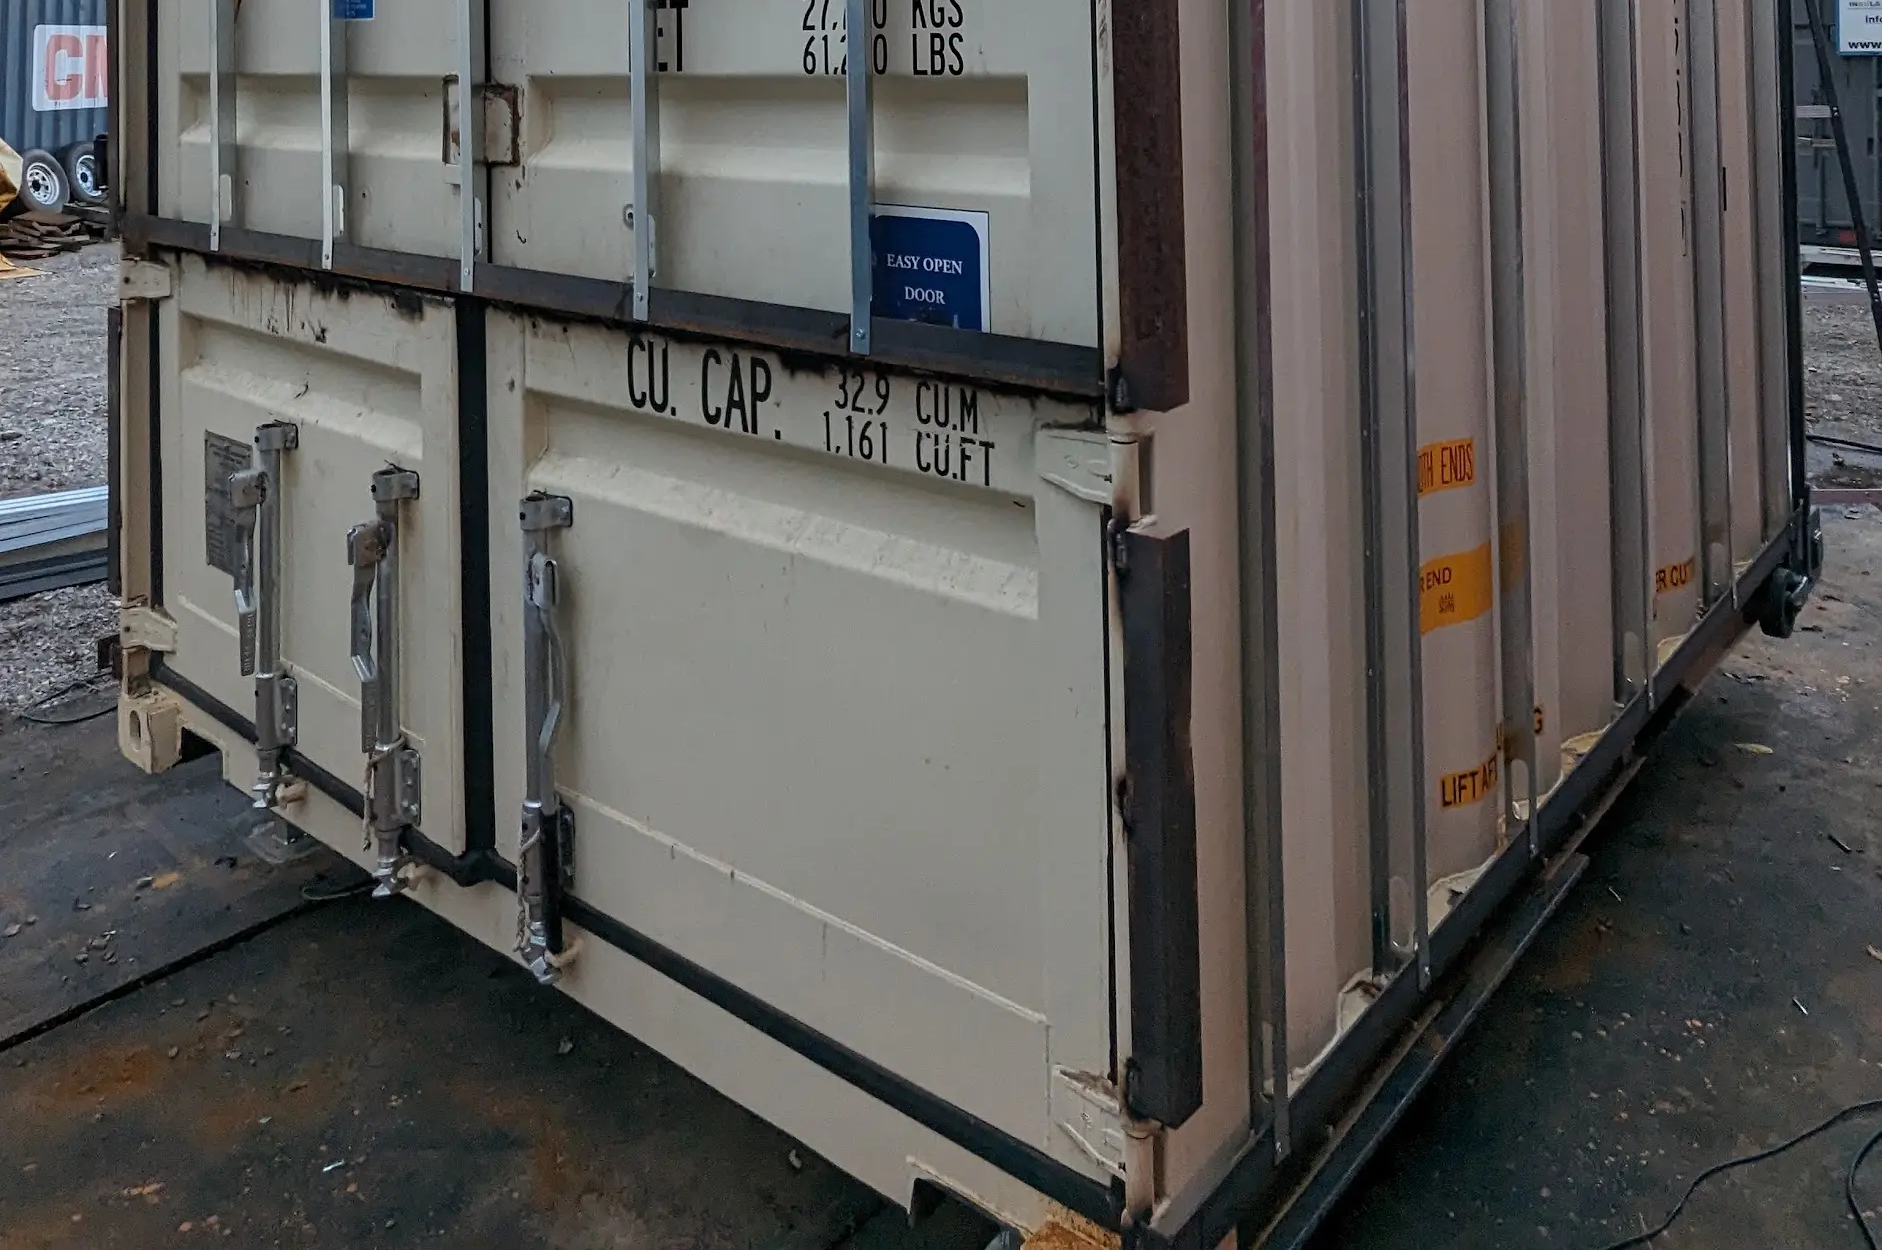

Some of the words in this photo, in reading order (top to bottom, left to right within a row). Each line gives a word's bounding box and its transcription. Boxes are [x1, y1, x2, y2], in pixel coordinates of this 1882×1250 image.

[911, 32, 964, 76] LBS
[887, 253, 920, 270] EASY
[923, 257, 963, 275] OPEN
[904, 286, 946, 305] DOOR
[627, 334, 677, 417] CU.
[701, 348, 782, 441] CAP.
[834, 364, 891, 417] 32.9
[822, 410, 888, 465] 1,161
[1441, 442, 1474, 485] ENDS
[1441, 770, 1480, 808] LIFT
